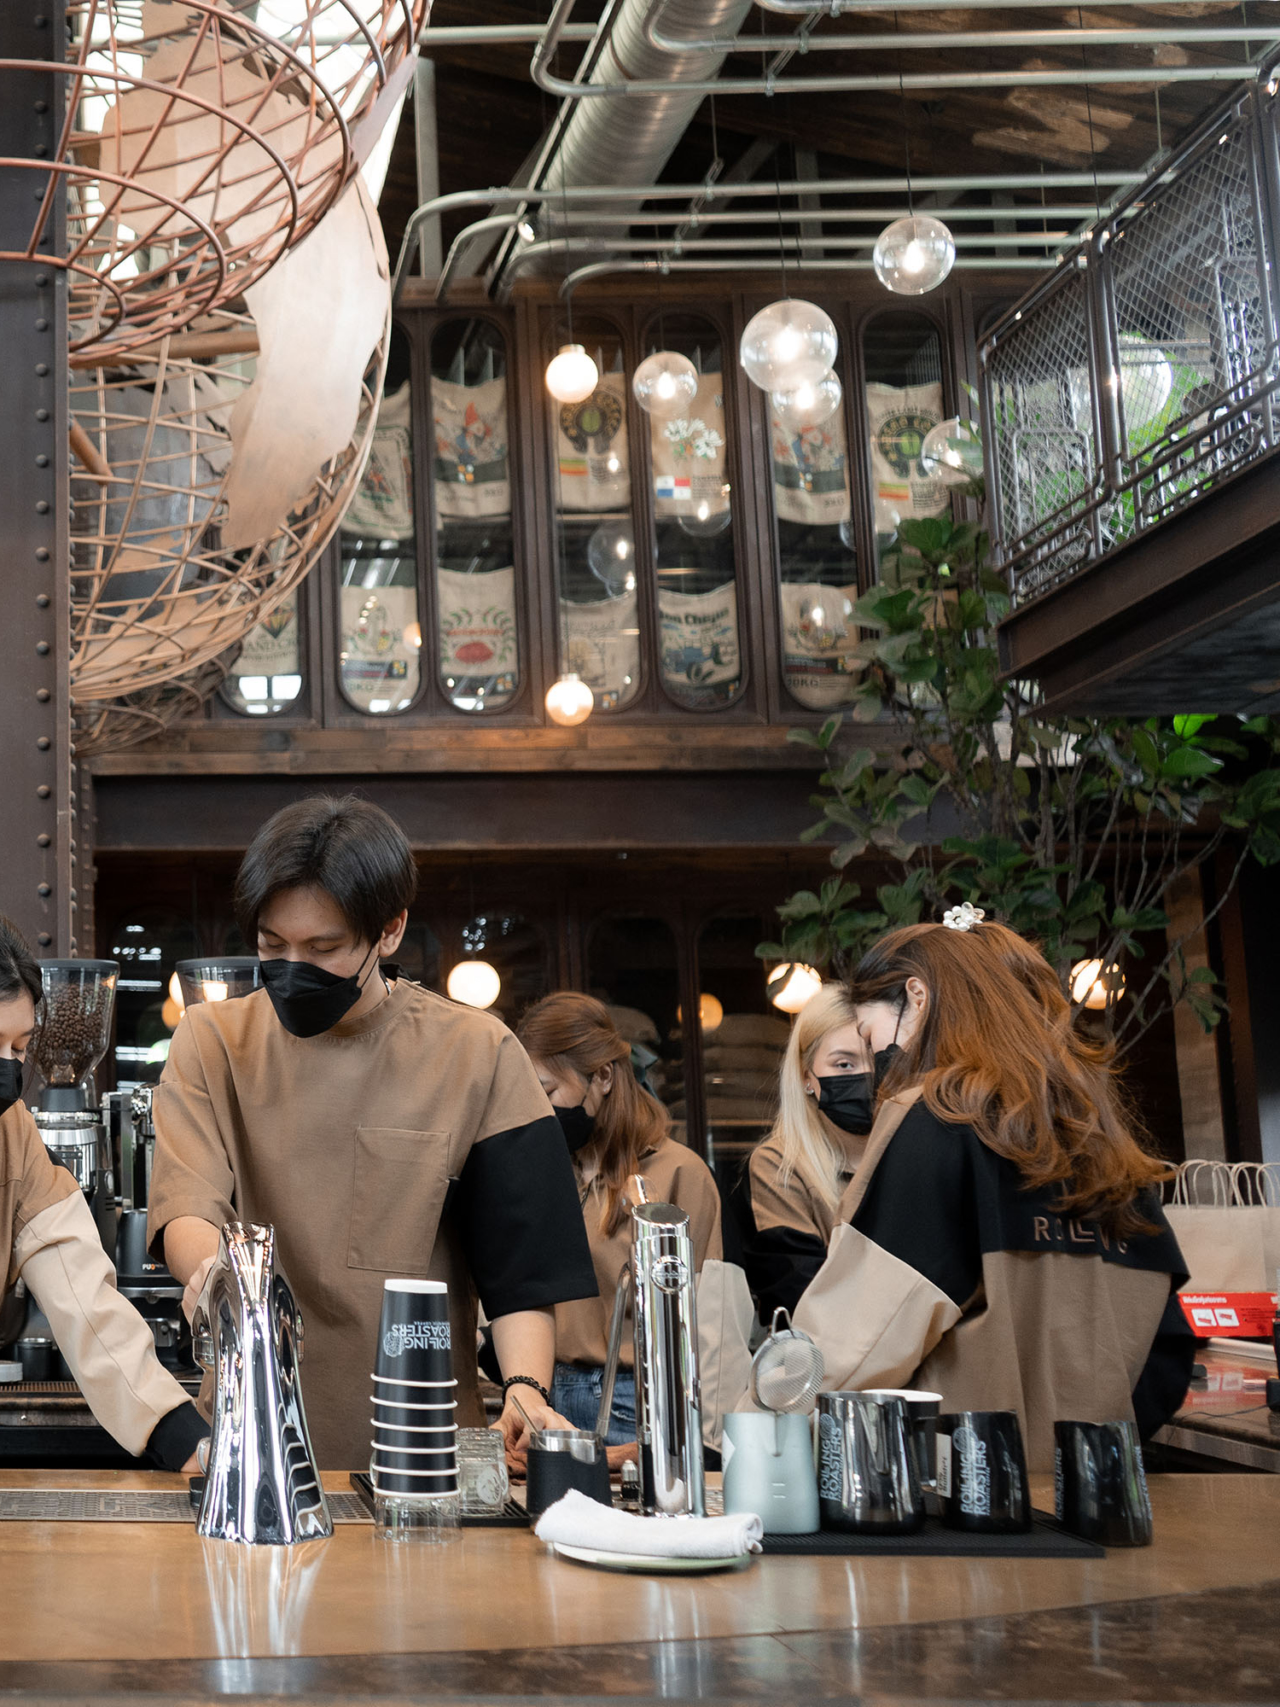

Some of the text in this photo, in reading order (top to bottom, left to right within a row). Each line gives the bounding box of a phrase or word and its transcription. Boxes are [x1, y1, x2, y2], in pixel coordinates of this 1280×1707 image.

[391, 1323, 451, 1338] ROASTERS
[404, 1337, 451, 1350] ROLLING
[820, 1438, 832, 1500] ROLLING
[828, 1427, 842, 1501] ROASTERS
[960, 1453, 973, 1513] ROLLING
[973, 1440, 987, 1515] ROASTERS
